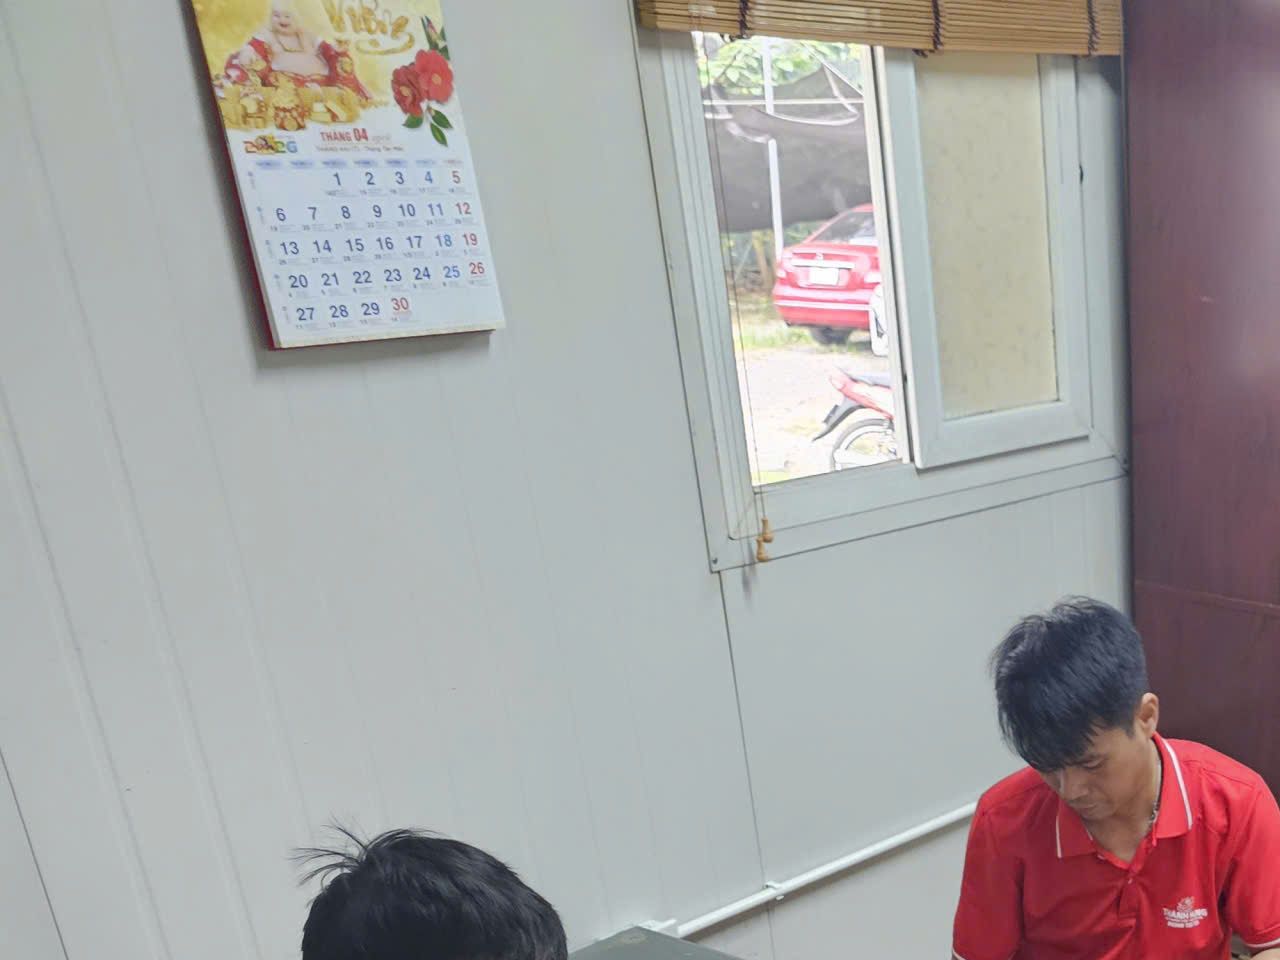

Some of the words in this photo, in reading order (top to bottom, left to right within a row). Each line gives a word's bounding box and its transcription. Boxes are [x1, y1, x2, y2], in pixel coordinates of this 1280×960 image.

[353, 127, 369, 142] 04
[333, 172, 341, 186] 1
[365, 172, 375, 185] 2
[395, 171, 405, 185] 3
[424, 171, 433, 184] 4
[451, 171, 461, 184] 5
[276, 208, 286, 221] 6
[308, 207, 317, 220] 7
[340, 205, 351, 219] 8
[372, 205, 382, 218] 9
[398, 204, 416, 217] 10
[427, 203, 444, 217] 11
[455, 202, 472, 215] 12
[280, 241, 300, 256] 13
[313, 240, 332, 254] 14
[345, 238, 365, 252] 15
[376, 237, 394, 250] 16
[406, 235, 422, 249] 17
[434, 234, 452, 248] 18
[462, 233, 478, 246] 19
[288, 275, 308, 289] 20
[321, 272, 340, 286] 21
[352, 270, 373, 284] 22
[383, 269, 402, 282] 23
[412, 267, 431, 280] 24
[442, 265, 461, 279] 25
[468, 262, 485, 275] 26
[296, 307, 315, 321] 27
[329, 304, 349, 318] 28
[360, 302, 380, 316] 29
[391, 297, 410, 311] 30
